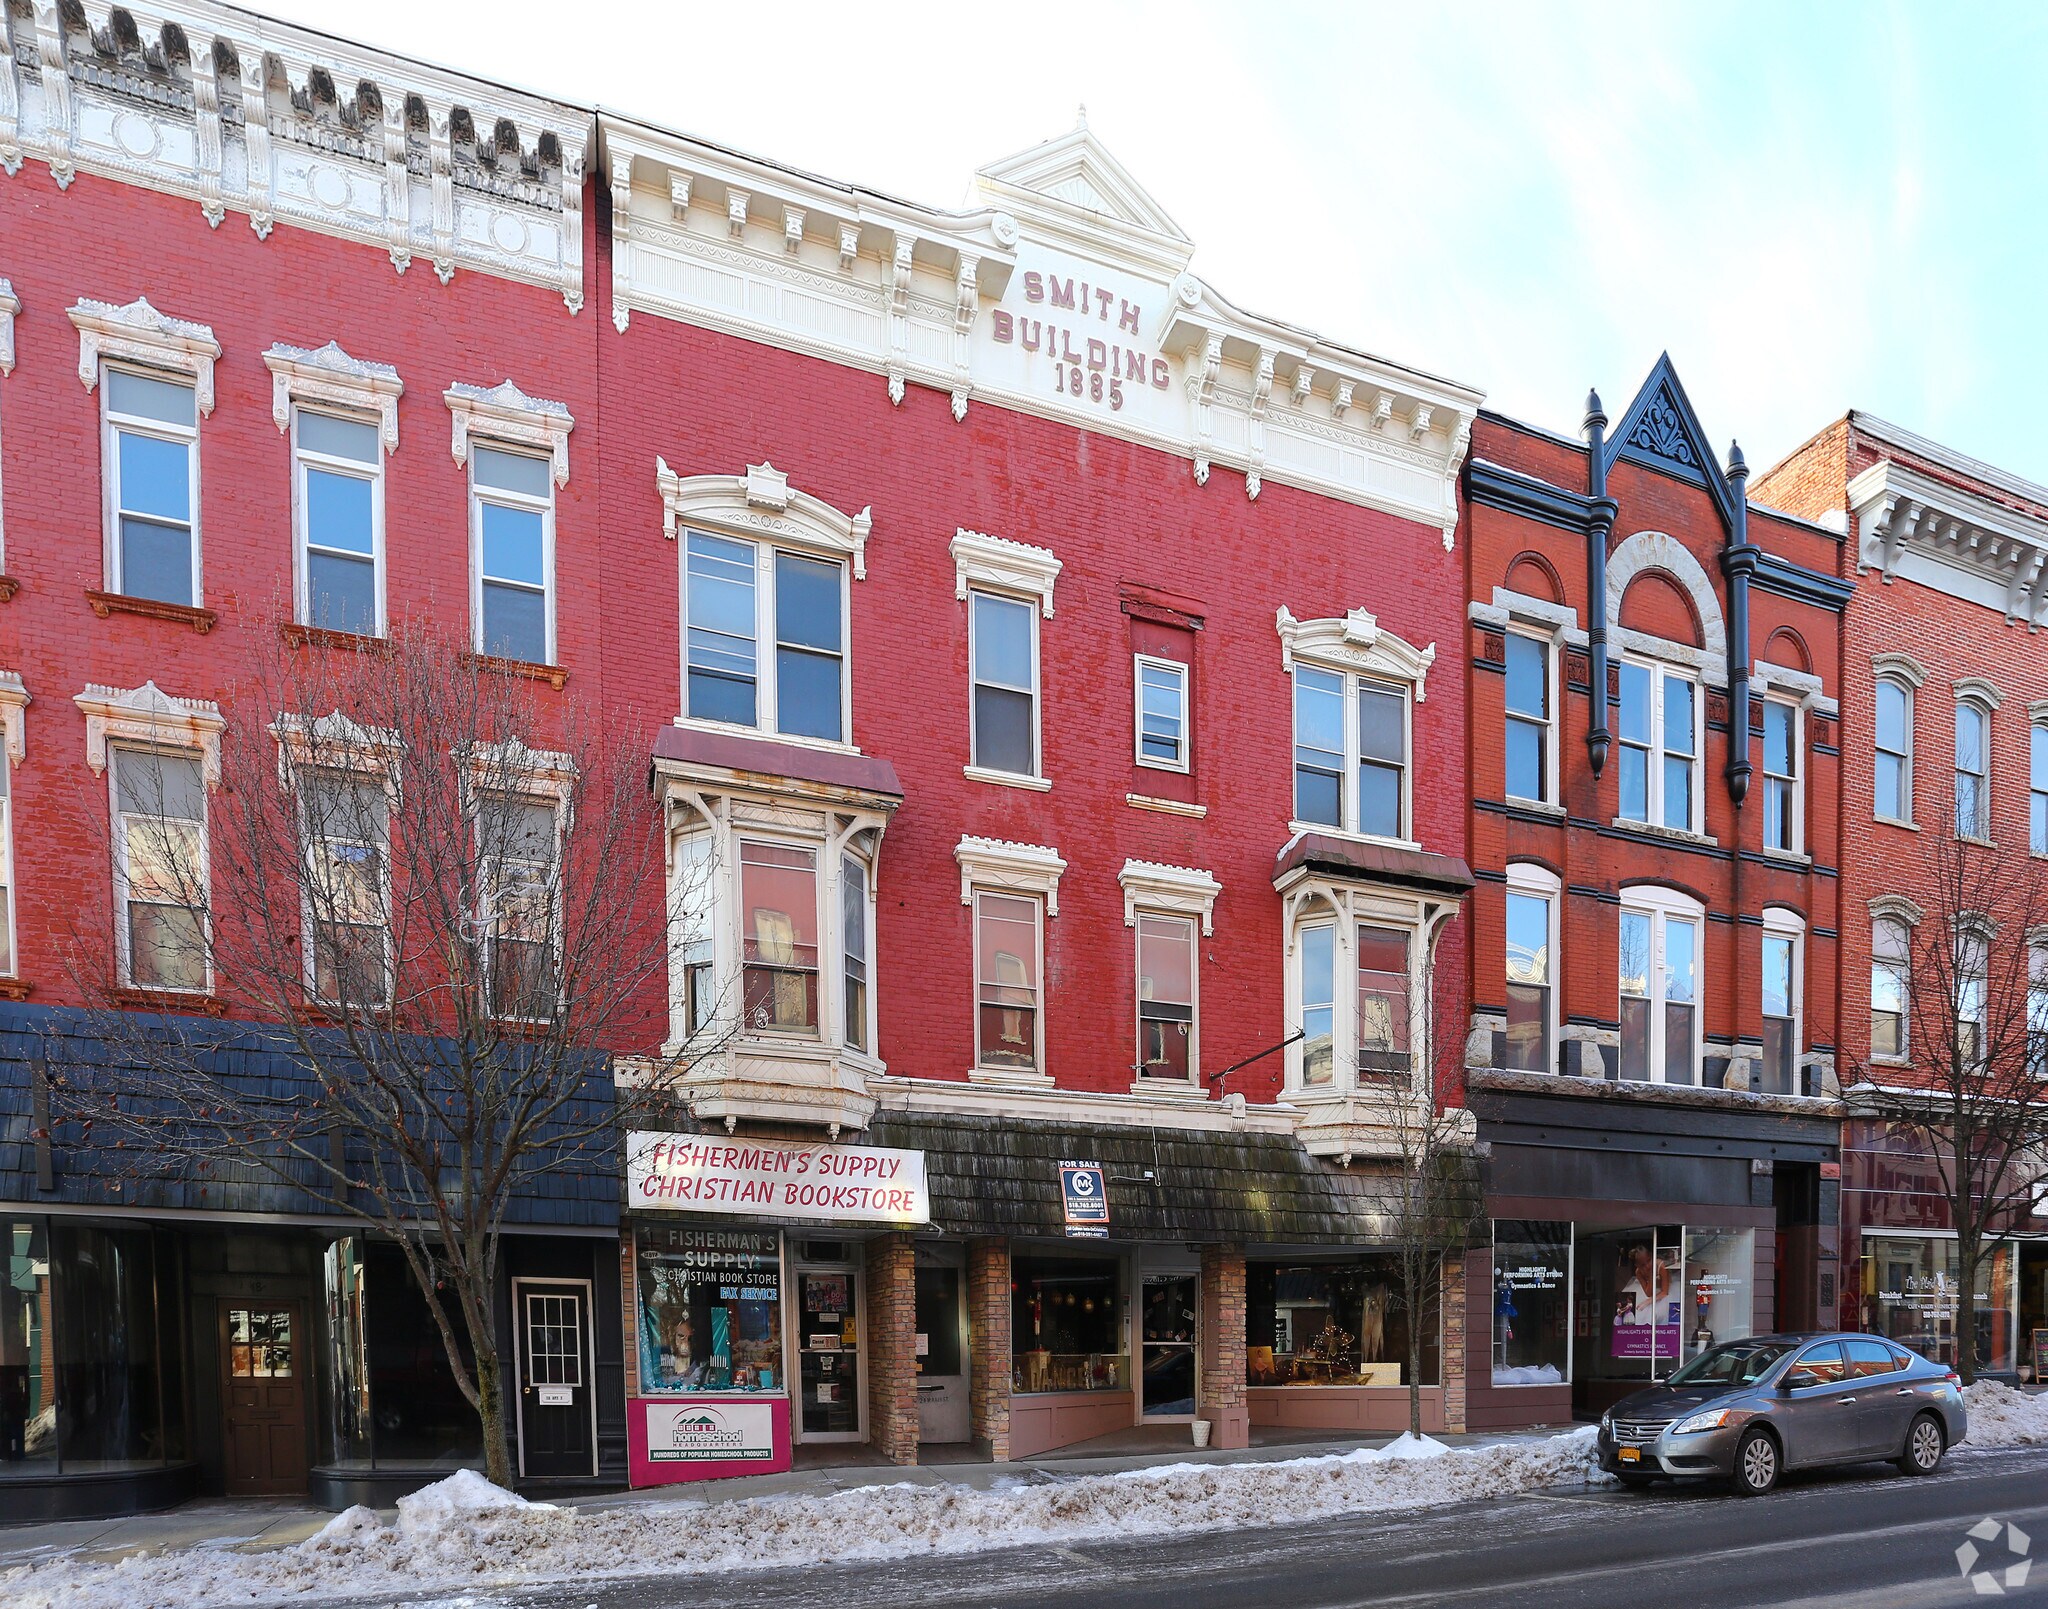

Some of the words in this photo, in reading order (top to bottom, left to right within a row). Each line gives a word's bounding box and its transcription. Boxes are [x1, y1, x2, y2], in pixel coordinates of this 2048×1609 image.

[1024, 270, 1140, 335] SMITH
[992, 309, 1170, 390] BUILDING
[1055, 363, 1124, 411] 1885
[652, 1142, 811, 1174] FISHERMEN'S
[819, 1154, 901, 1179] SUPPLY
[1060, 1160, 1077, 1168] FOR
[643, 1174, 775, 1203] CHRISTIAN
[784, 1183, 915, 1212] BOOKSTORE
[669, 1230, 776, 1251] FISHERMAN'S
[684, 1251, 756, 1270] SUPPLY
[667, 1269, 717, 1283] CHRISTIAN
[719, 1272, 744, 1284] BOOK
[746, 1273, 778, 1285] STORE
[720, 1286, 738, 1300] FAX
[741, 1287, 778, 1301] SERVICE
[672, 1429, 743, 1443] homeschool
[653, 1450, 680, 1458] HUNDREDS
[680, 1450, 687, 1458] OF
[687, 1450, 710, 1458] POPULAR
[711, 1450, 742, 1458] HOMESCHOOL
[743, 1450, 769, 1458] PRODUCTS
